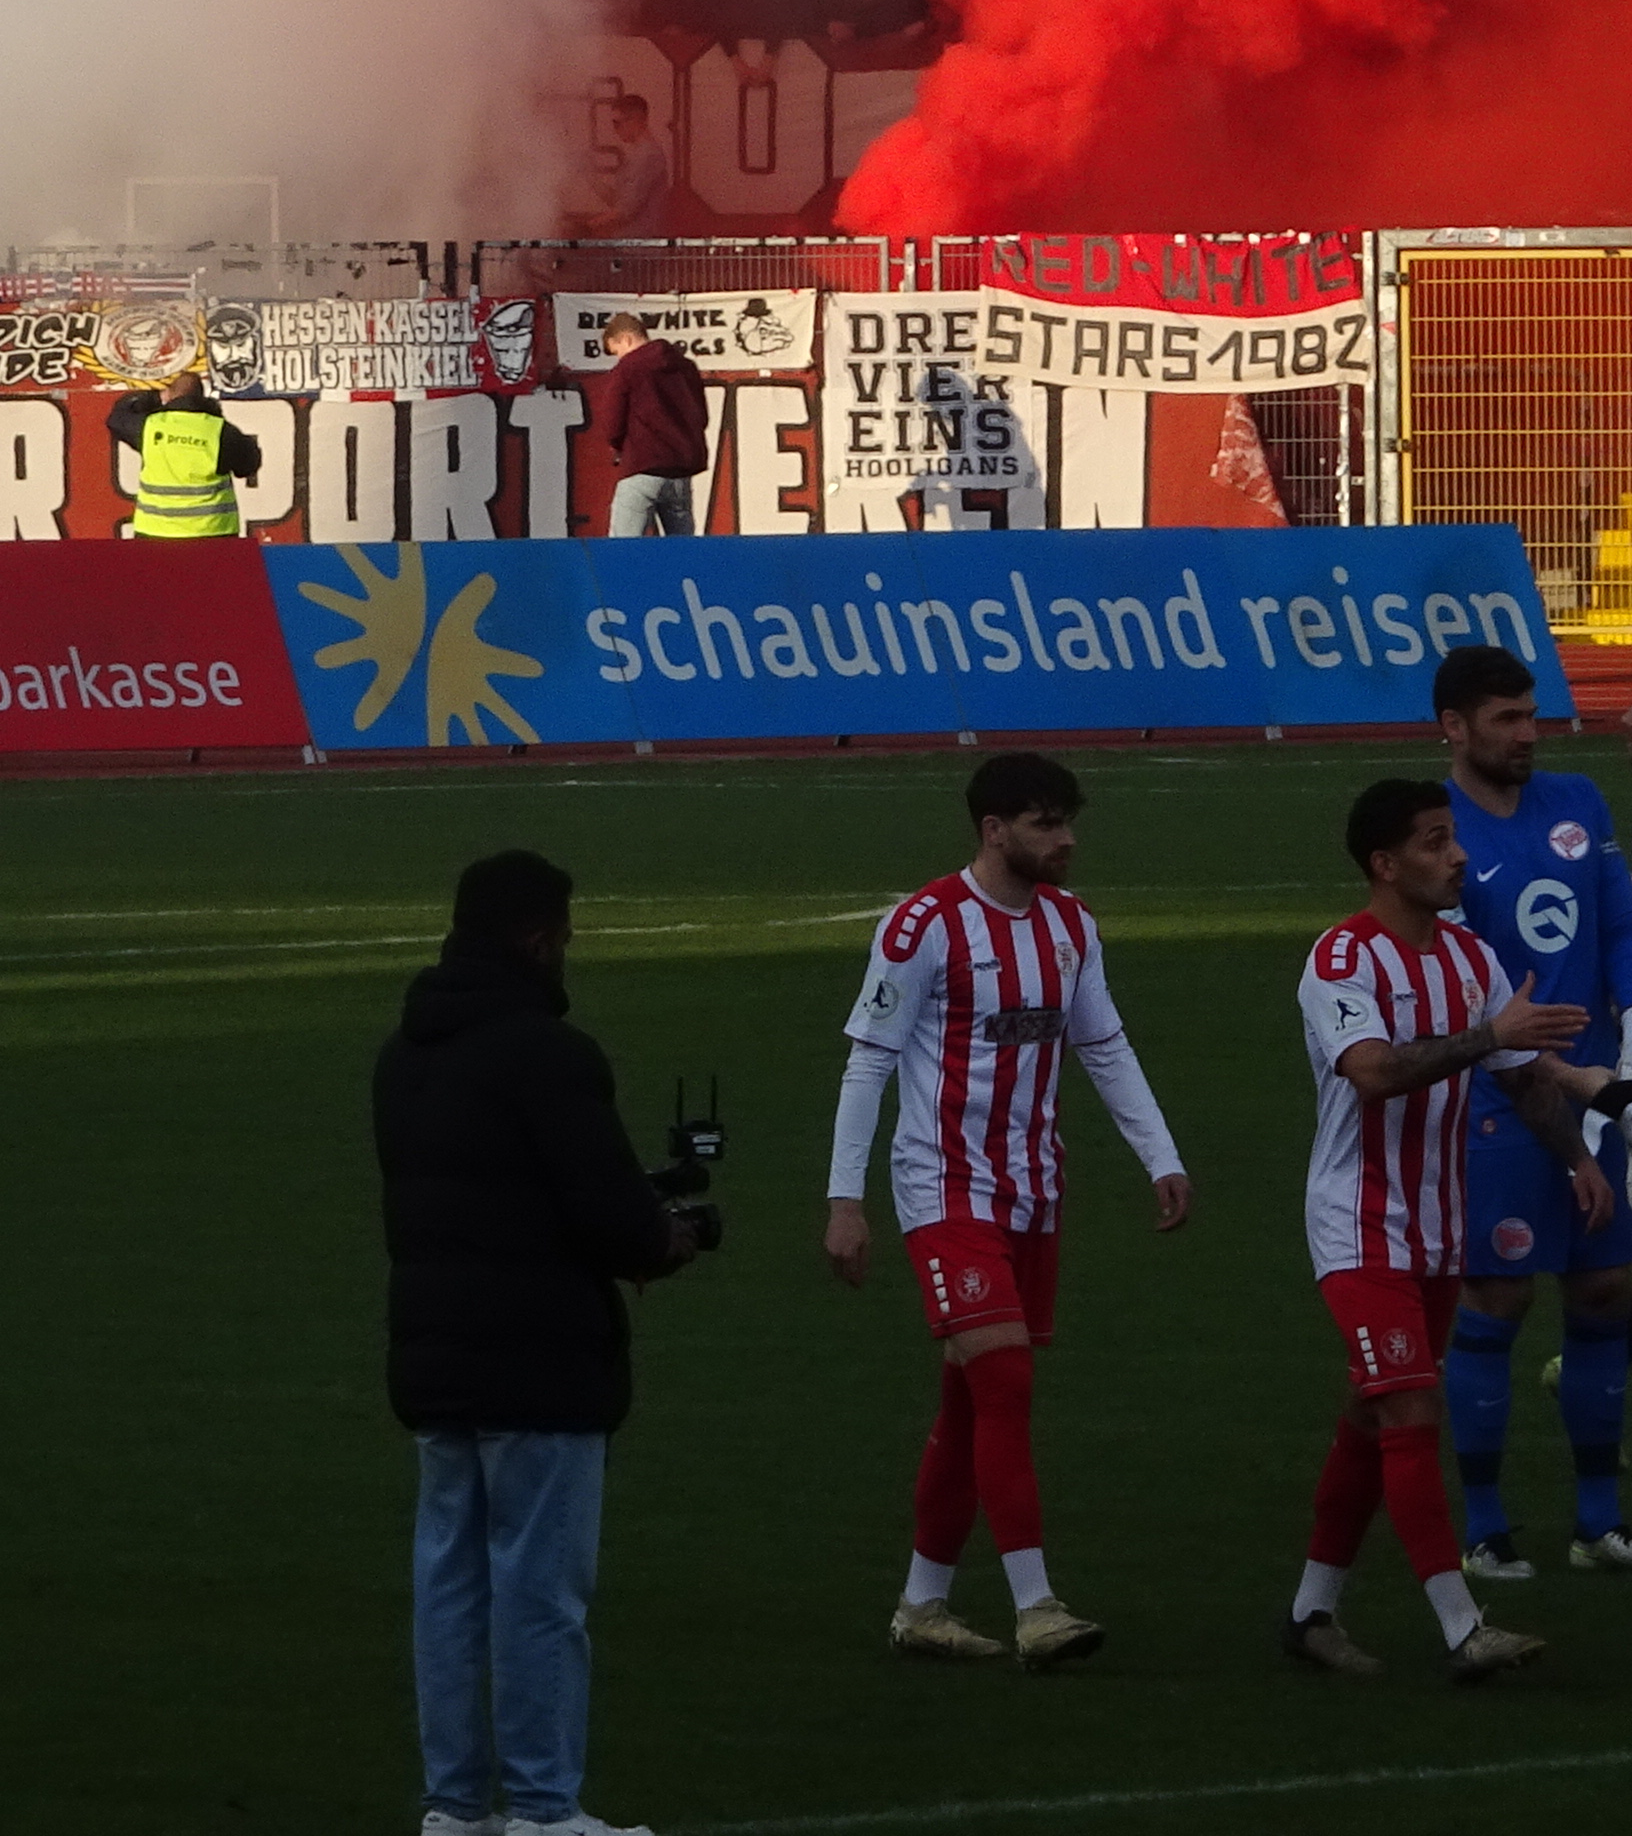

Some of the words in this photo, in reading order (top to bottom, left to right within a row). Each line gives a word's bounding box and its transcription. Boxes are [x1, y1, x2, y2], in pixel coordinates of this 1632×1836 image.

[261, 302, 369, 346] HESSEN
[374, 300, 479, 345] KASSEL
[264, 347, 406, 391] HOLSTEIN
[410, 345, 479, 389] KIEL
[848, 361, 1011, 403] VIER
[848, 409, 1011, 453] EINS
[115, 392, 585, 543] PORT
[846, 457, 1019, 479] HOOLIGANS
[586, 568, 1226, 682] schauinsland
[1239, 566, 1538, 669] reisen
